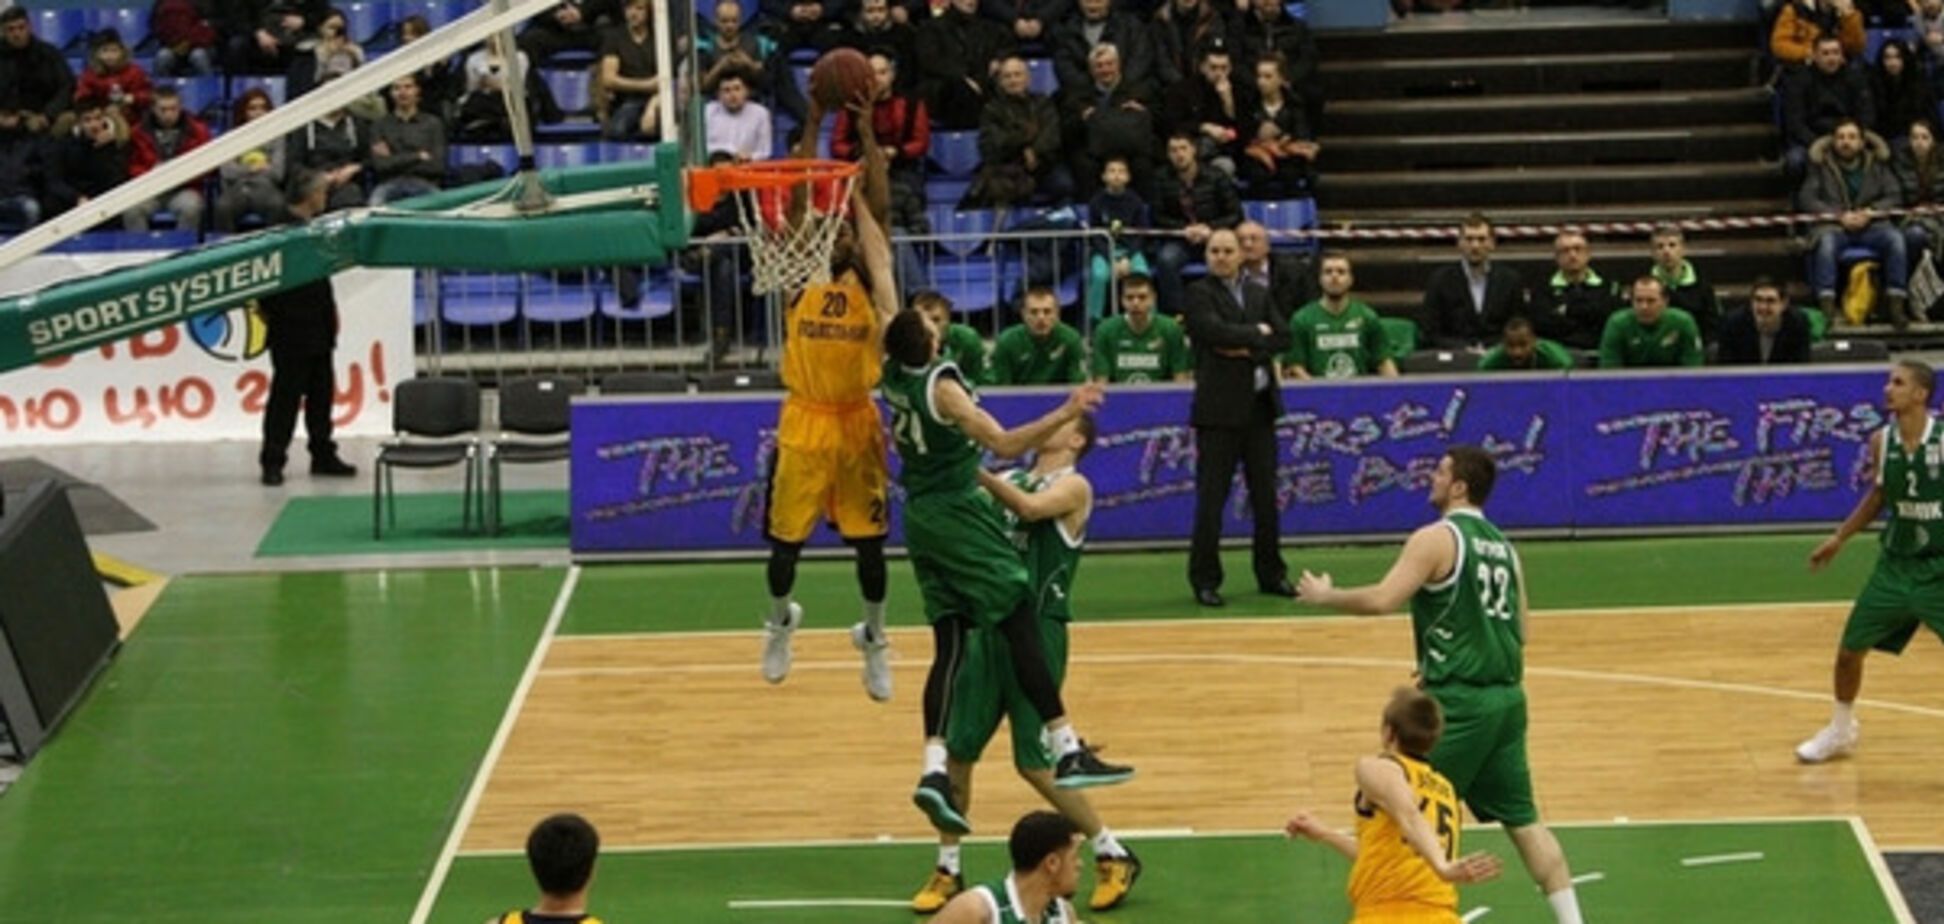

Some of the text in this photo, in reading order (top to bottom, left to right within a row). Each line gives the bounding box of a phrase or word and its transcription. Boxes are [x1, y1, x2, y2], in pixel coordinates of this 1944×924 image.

[28, 251, 283, 345] SPORT SYSTEM
[597, 436, 739, 495] THE
[1096, 425, 1197, 484] TH
[1596, 410, 1739, 469] THE
